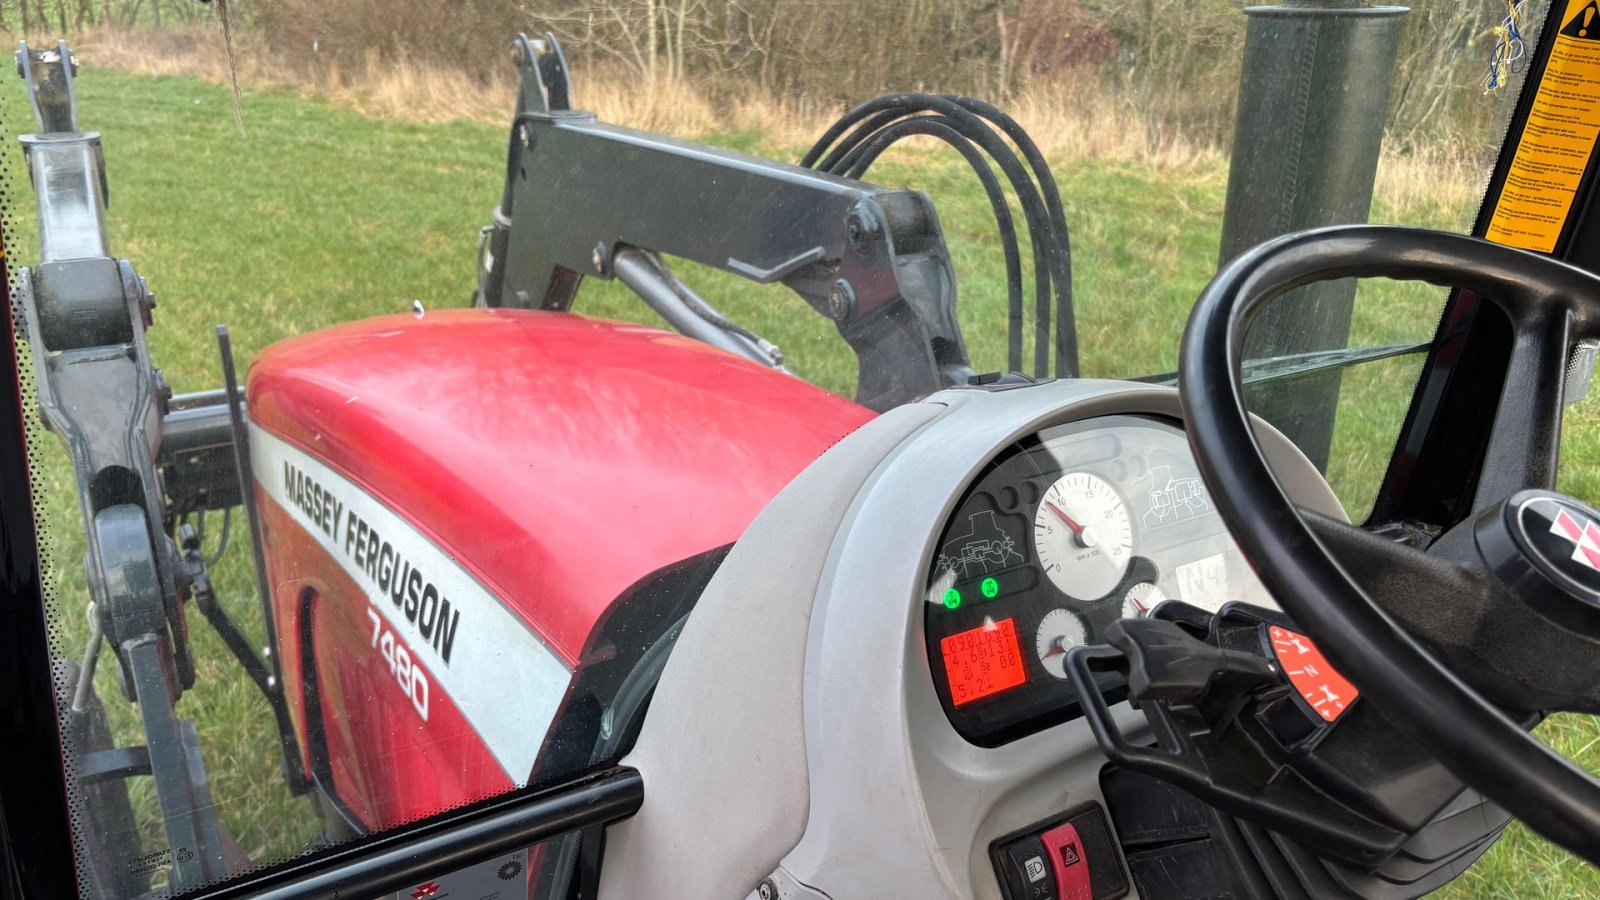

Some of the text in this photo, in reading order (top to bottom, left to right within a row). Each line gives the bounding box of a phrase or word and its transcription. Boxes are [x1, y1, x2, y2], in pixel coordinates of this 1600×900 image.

[1085, 490, 1095, 500] 15
[1057, 496, 1067, 507] 10
[1104, 509, 1114, 520] 20
[1047, 526, 1053, 535] 5
[1112, 547, 1122, 557] 25
[284, 460, 460, 666] MASSEY FERGUSON
[1055, 563, 1061, 573] 0
[367, 608, 429, 722] 7480
[1303, 663, 1320, 678] N
